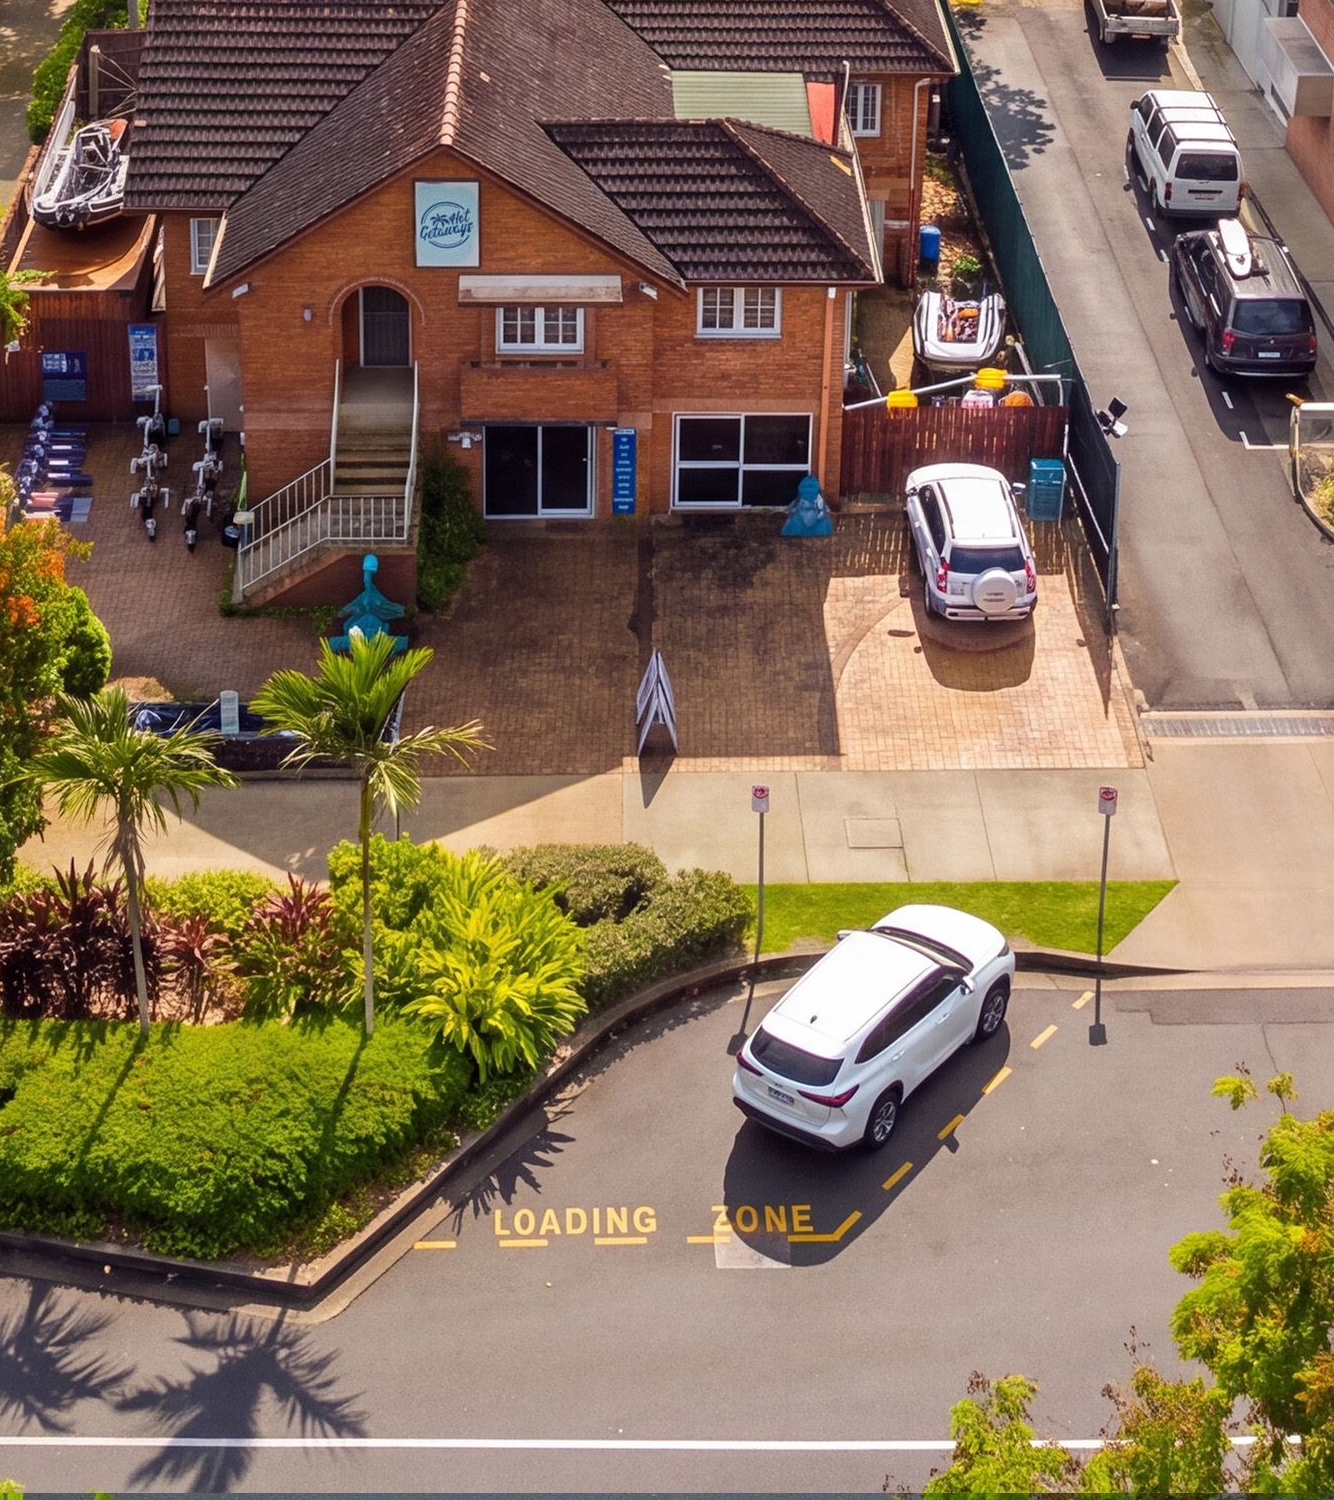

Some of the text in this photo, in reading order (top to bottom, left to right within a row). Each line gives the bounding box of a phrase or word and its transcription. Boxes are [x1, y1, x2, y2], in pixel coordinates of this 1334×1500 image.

[419, 221, 474, 241] Getaways
[493, 1204, 814, 1236] LOADING ZONE
